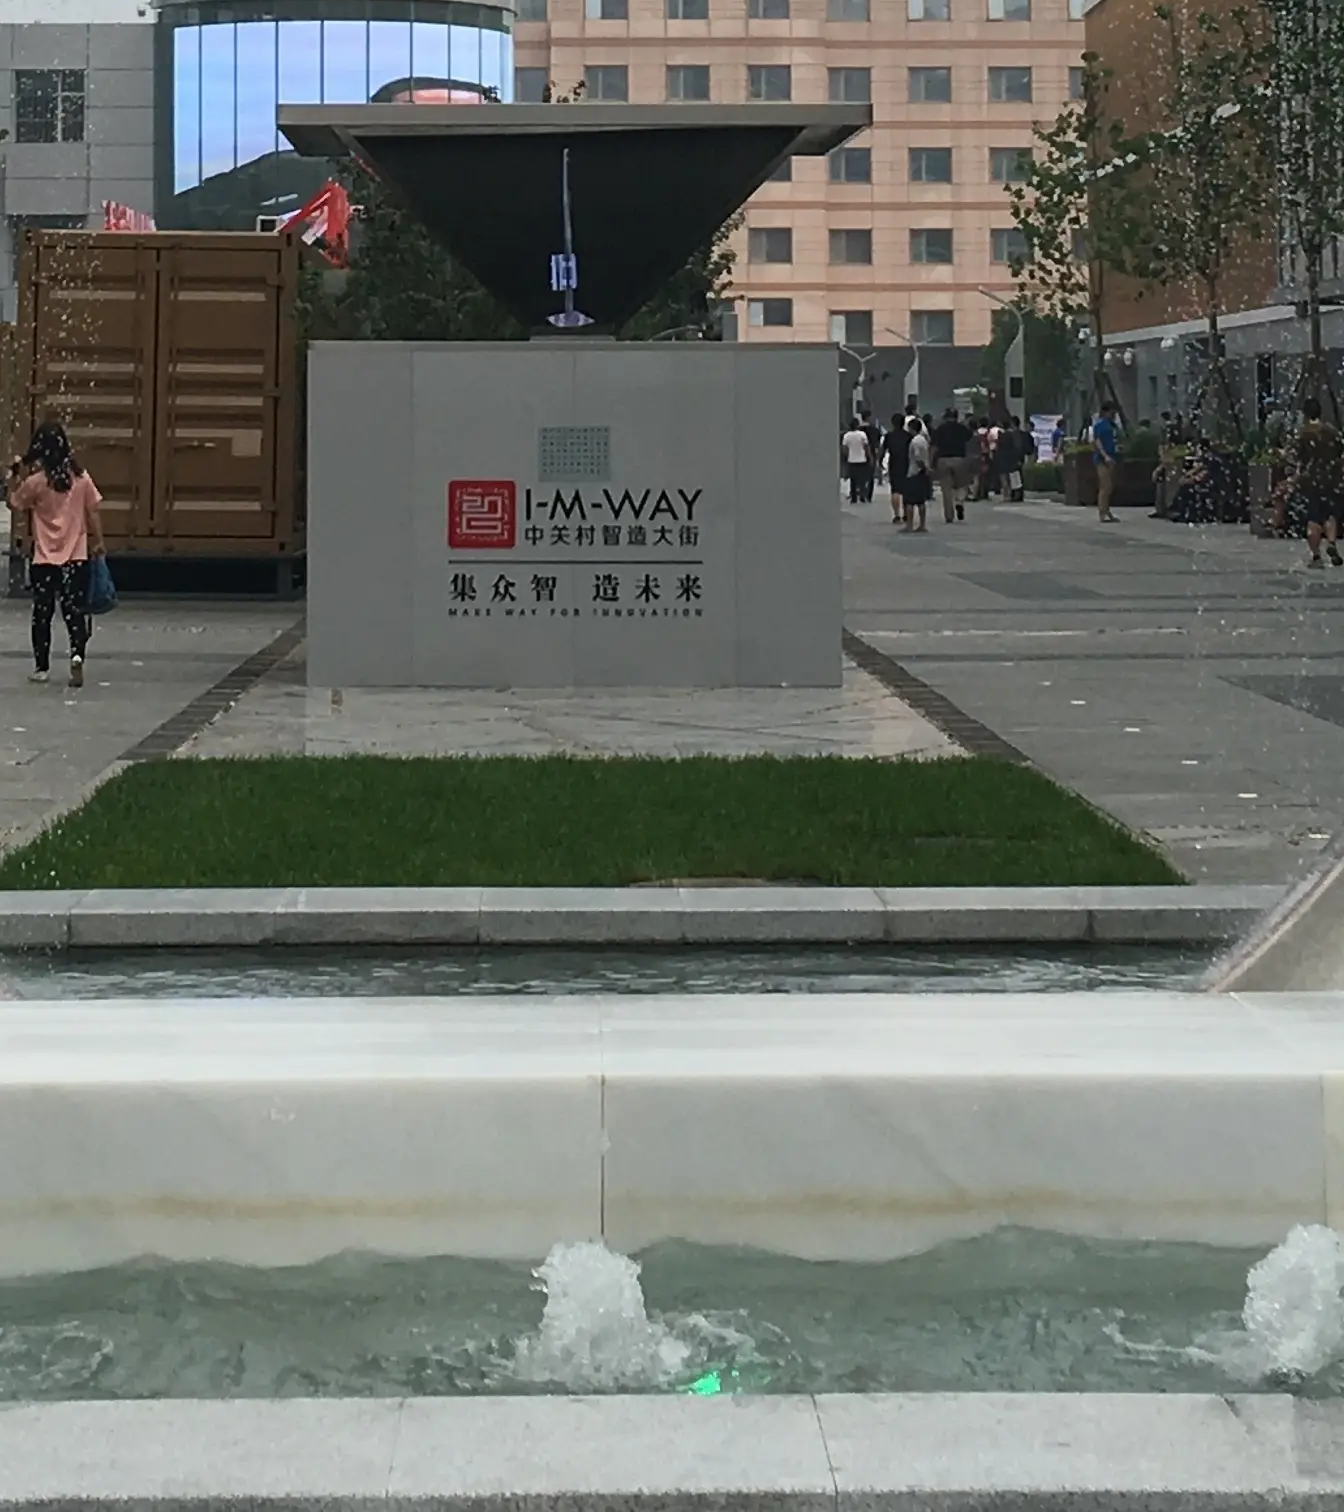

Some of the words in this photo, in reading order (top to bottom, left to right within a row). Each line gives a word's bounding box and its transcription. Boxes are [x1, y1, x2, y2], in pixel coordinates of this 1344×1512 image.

[524, 488, 704, 521] I-M-WAY
[524, 524, 700, 547] 中关村智造大街
[448, 573, 559, 603] 集众智
[592, 573, 704, 603] 造未来
[448, 607, 492, 618] MAKE
[505, 607, 538, 618] WAY
[549, 607, 581, 618] FOR
[593, 607, 704, 618] INNOVATION
